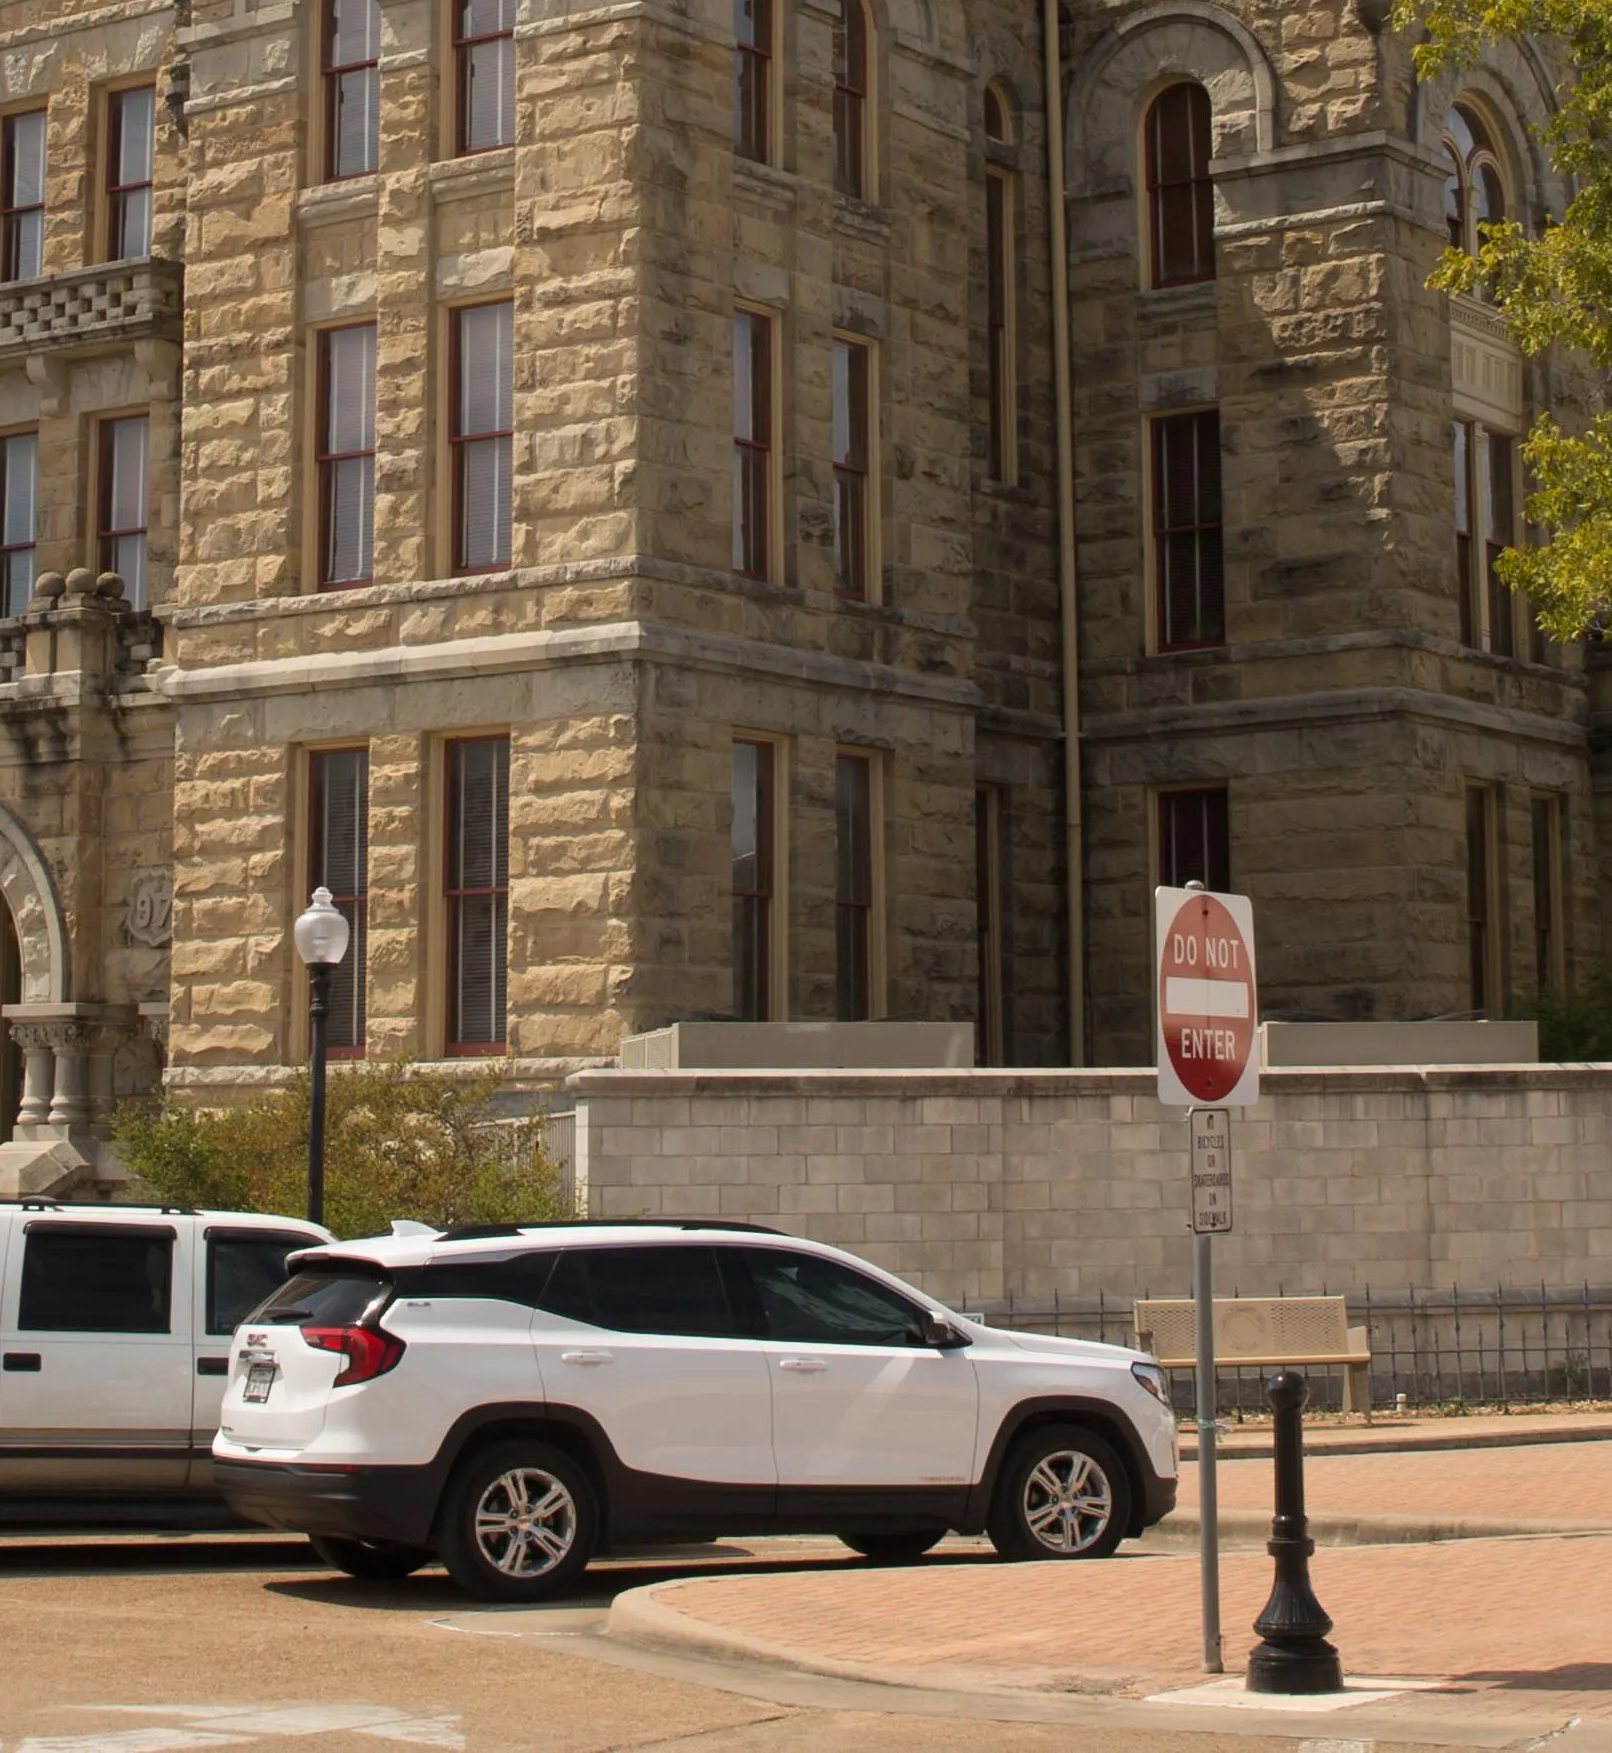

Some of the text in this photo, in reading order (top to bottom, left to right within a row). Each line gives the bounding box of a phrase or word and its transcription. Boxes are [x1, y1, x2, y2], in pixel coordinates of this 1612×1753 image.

[1174, 934, 1239, 968] DO NOT
[1181, 1028, 1236, 1060] ENTER
